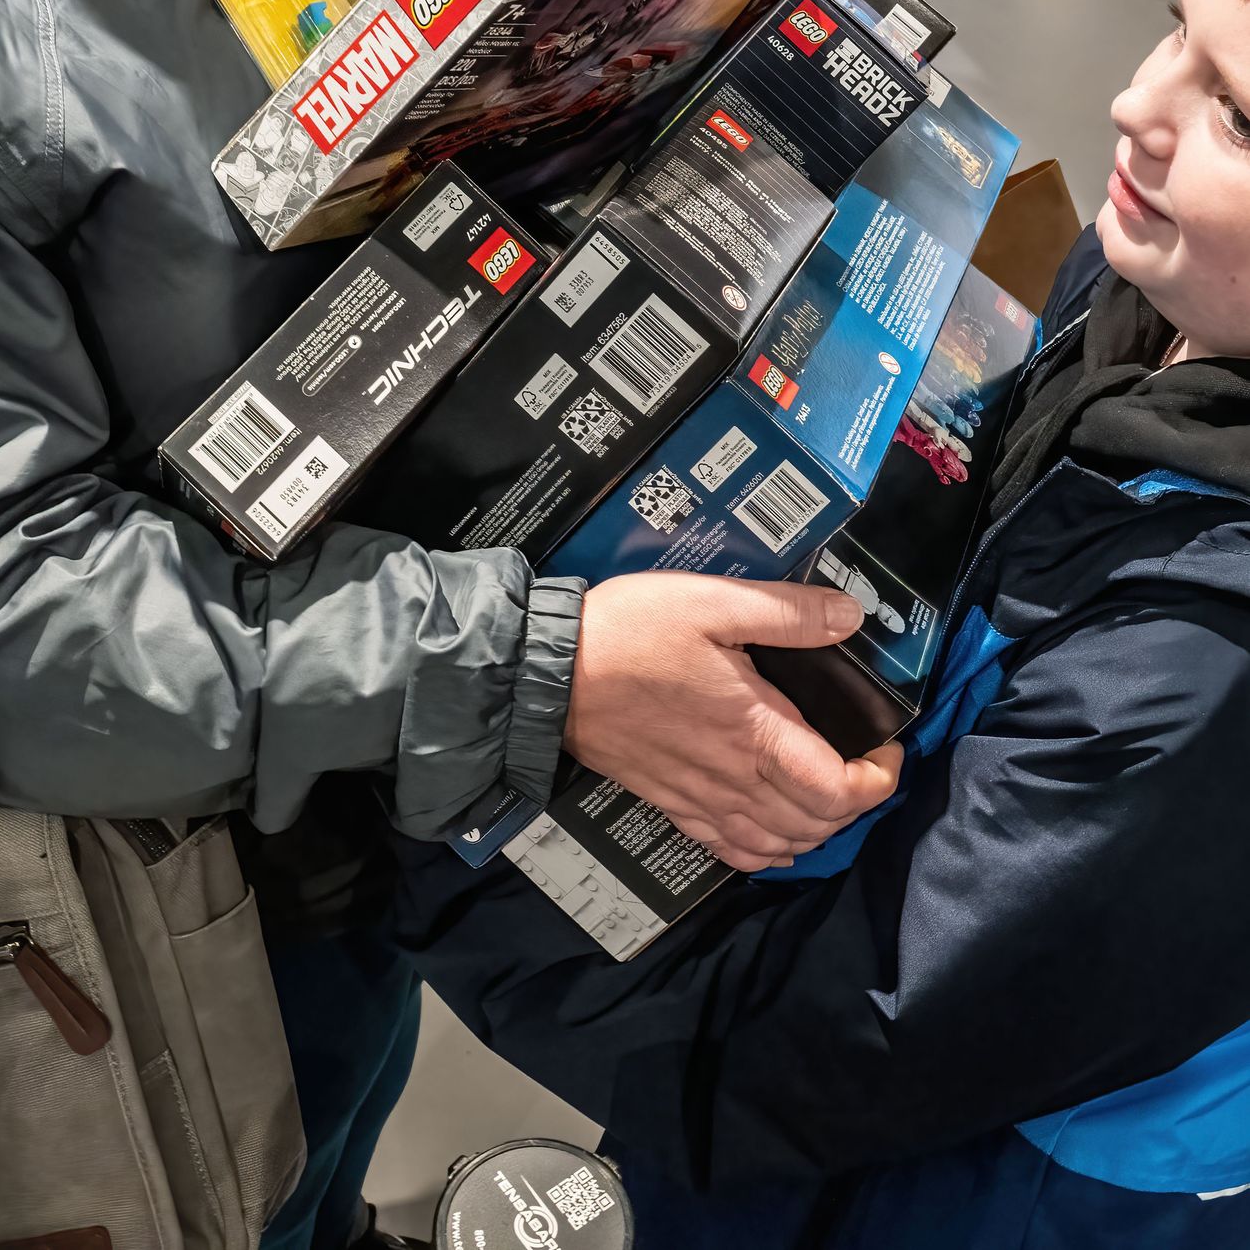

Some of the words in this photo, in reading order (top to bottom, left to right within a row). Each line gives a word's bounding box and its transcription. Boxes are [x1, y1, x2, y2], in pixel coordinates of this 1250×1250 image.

[790, 11, 828, 43] LEGO
[767, 35, 794, 61] 40628
[450, 58, 476, 72] 220
[296, 14, 408, 144] MARVEL
[851, 52, 914, 112] BRICK
[750, 106, 764, 120] MADE
[699, 127, 728, 149] 40495
[712, 117, 750, 145] LEGO
[466, 213, 492, 242] 42147
[484, 240, 520, 282] LEGO
[595, 236, 626, 265] 6458505
[367, 294, 379, 306] and
[375, 282, 391, 297] LEGO
[338, 301, 353, 317] LEGO
[348, 310, 363, 326] LEGO
[360, 302, 371, 313] the
[331, 332, 342, 343] are
[368, 285, 482, 405] TECHNIC
[580, 341, 601, 364] Item:
[596, 311, 628, 345] 6347562
[289, 351, 304, 367] LEGO
[308, 339, 335, 366] trademarks
[762, 366, 786, 398] LEGO
[281, 425, 302, 448] Item:
[254, 443, 285, 476] 6420672
[724, 493, 742, 511] Item:
[739, 471, 765, 497] 6426001
[697, 542, 713, 558] LEGO
